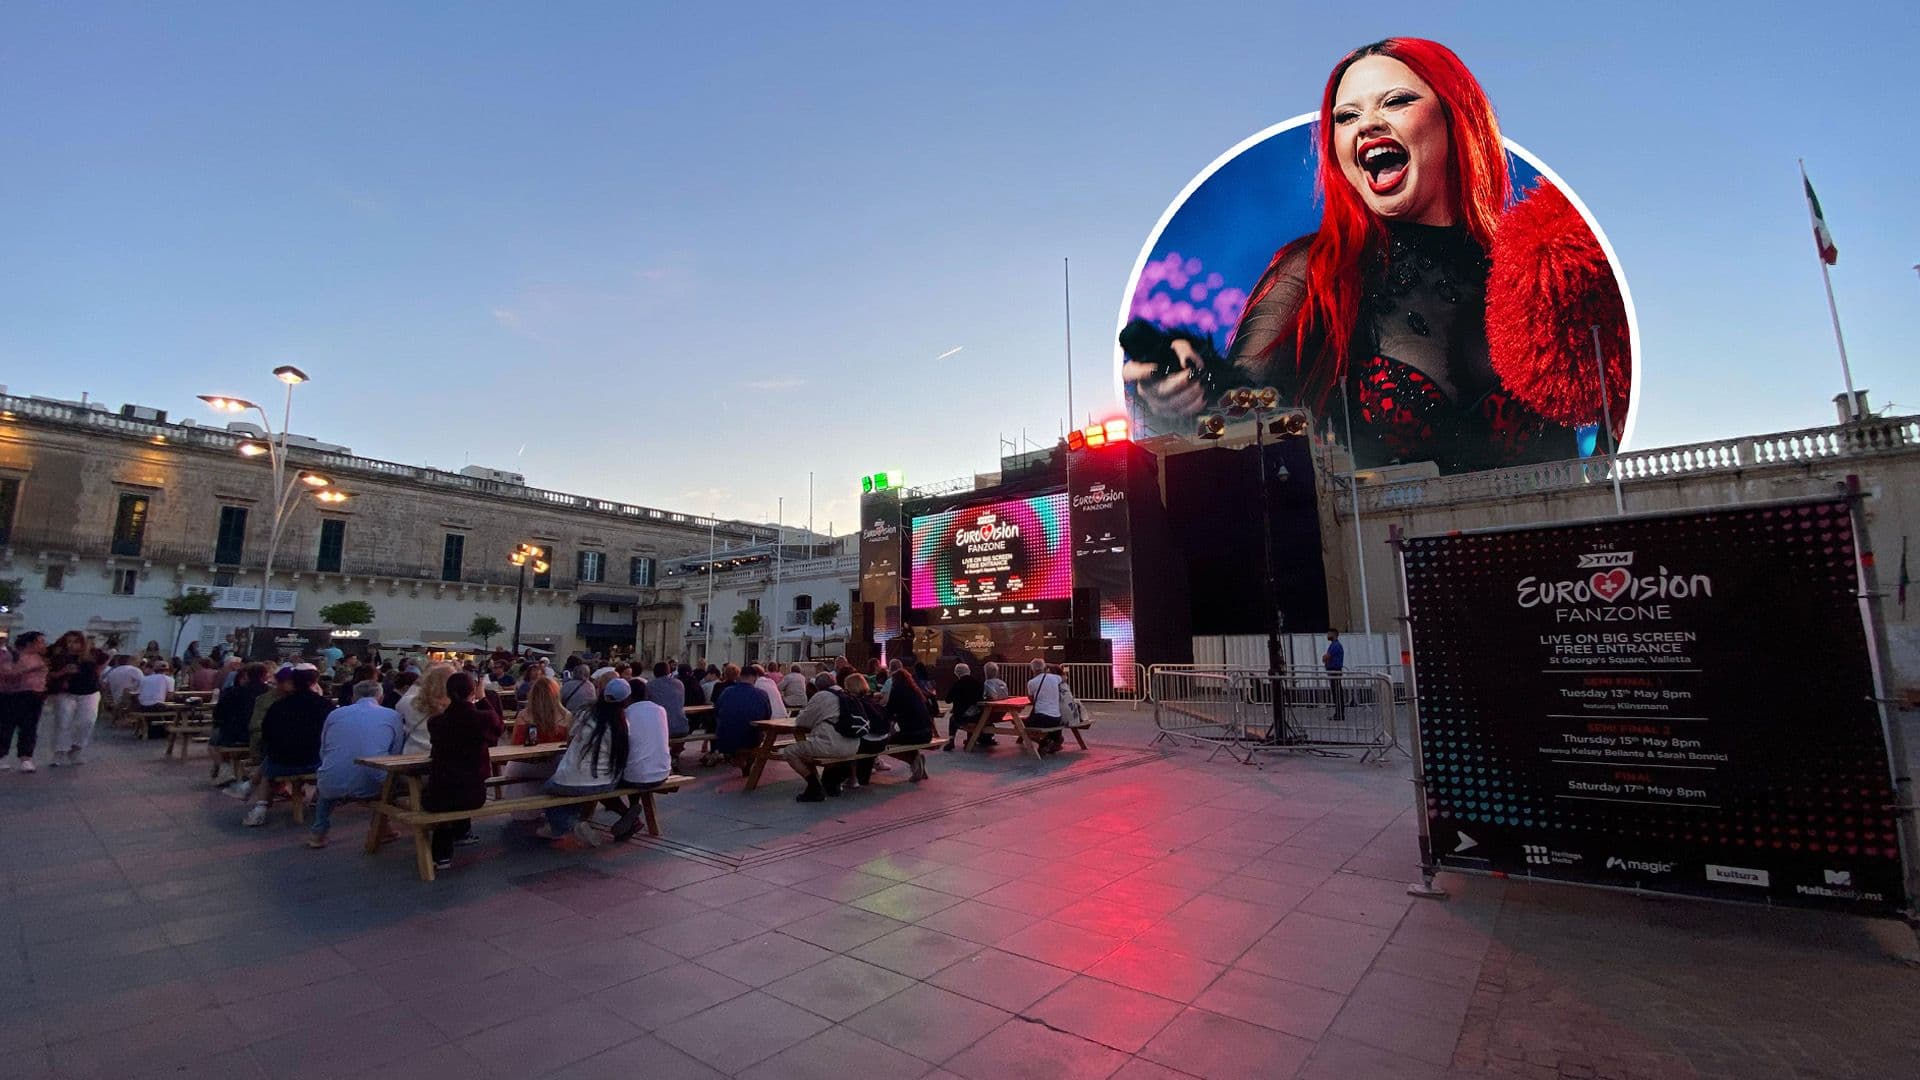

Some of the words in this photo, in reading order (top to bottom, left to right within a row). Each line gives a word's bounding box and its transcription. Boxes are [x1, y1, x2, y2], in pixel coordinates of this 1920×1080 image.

[968, 541, 1006, 553] FANZONE
[1595, 555, 1629, 564] TVM
[1556, 605, 1672, 623] FANZONE
[1540, 634, 1573, 645] LIVE
[1576, 633, 1598, 644] ON
[1603, 633, 1629, 643] BIG
[1633, 632, 1696, 643] SCREEN
[1555, 645, 1592, 654] FREE
[1597, 643, 1682, 654] ENTRANCE
[1549, 656, 1560, 664] St
[1562, 656, 1606, 665] George's
[1608, 656, 1648, 665] Square,
[1650, 656, 1692, 664] Valletta
[1616, 678, 1653, 686] FINAL
[1560, 689, 1608, 699] Tuesday
[1611, 689, 1631, 698] 13th
[1634, 690, 1659, 700] May
[1662, 690, 1691, 700] 8pm
[1562, 734, 1616, 745] Thursday
[1620, 736, 1640, 745] 15th
[1642, 738, 1668, 748] May
[1671, 738, 1700, 749] 8pm
[1571, 747, 1601, 757] Kelsey
[1604, 749, 1645, 758] Bellante
[1657, 751, 1686, 760] Sarah
[1688, 753, 1729, 762] Bonnici
[1568, 780, 1621, 794] Saturday
[1624, 784, 1645, 793] 17th
[1648, 786, 1673, 797] May
[1676, 787, 1706, 798] 8pm
[1628, 860, 1672, 874] magic
[1716, 868, 1759, 881] kultura
